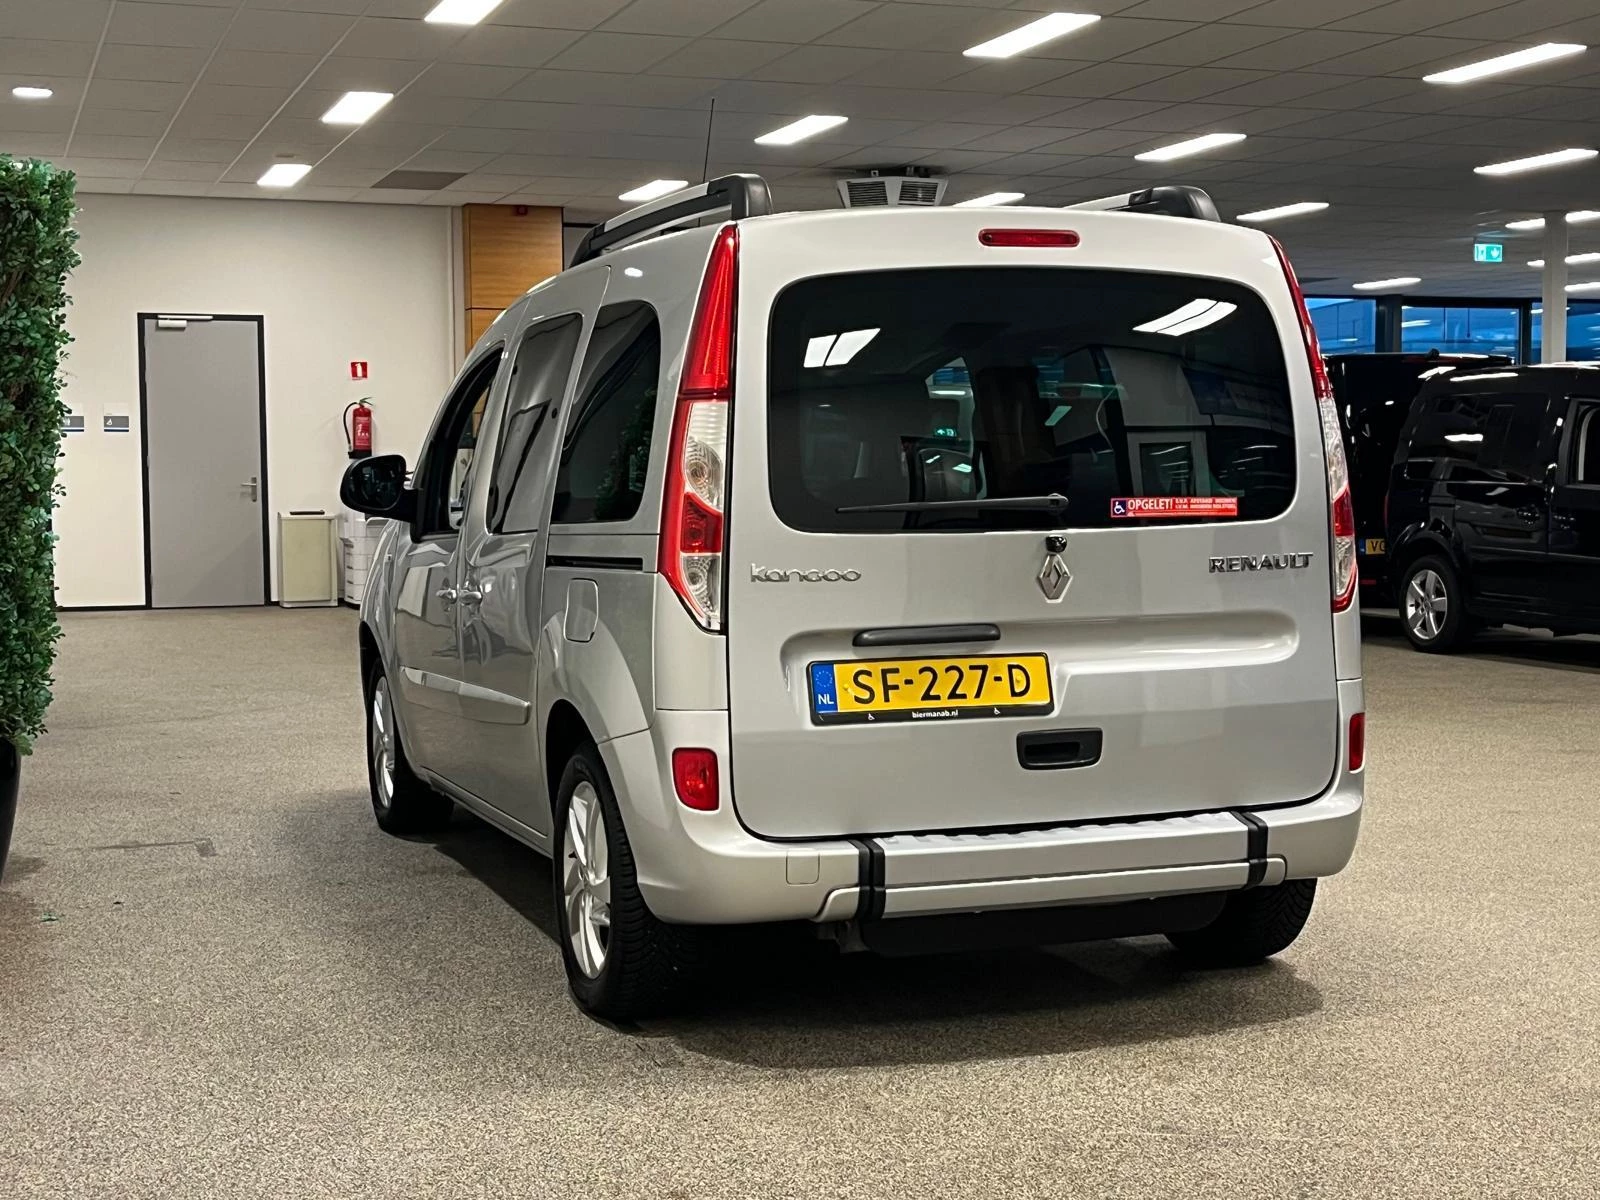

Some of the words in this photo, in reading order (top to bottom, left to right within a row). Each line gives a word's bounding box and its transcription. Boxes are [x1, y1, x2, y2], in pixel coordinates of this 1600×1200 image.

[1127, 498, 1173, 510] OPGELET!
[1208, 552, 1314, 573] RENAULT
[818, 694, 835, 705] NL
[852, 664, 1031, 704] SF-227-D
[911, 709, 959, 719] biermanab.nl
